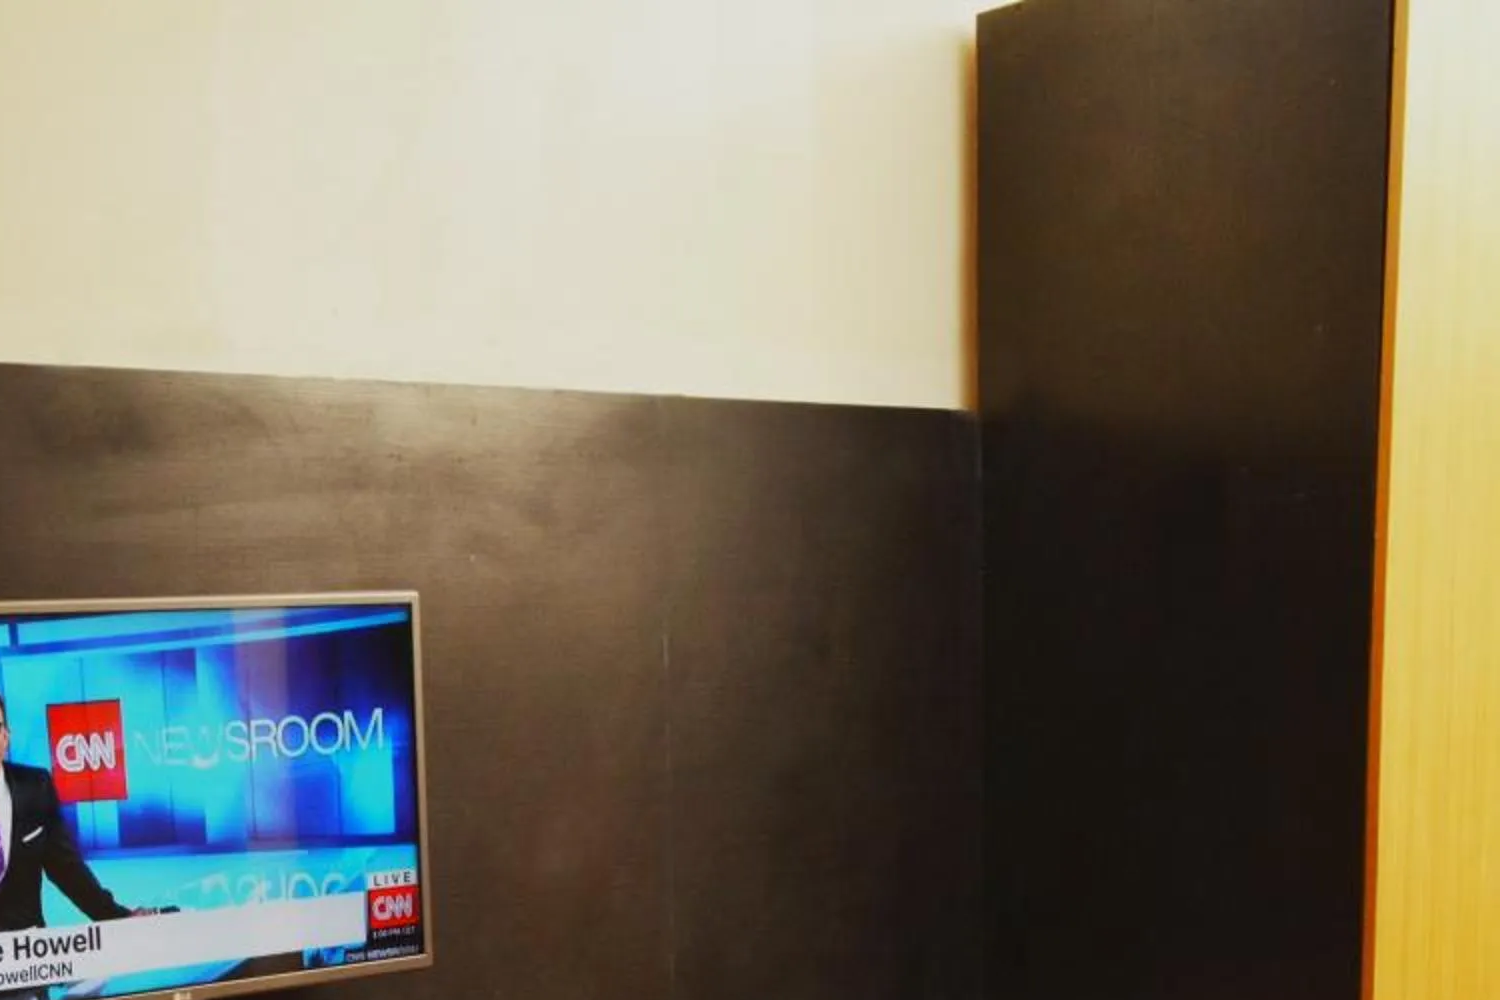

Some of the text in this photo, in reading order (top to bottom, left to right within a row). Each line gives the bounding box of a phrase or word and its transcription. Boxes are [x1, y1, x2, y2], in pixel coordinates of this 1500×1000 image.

[55, 707, 384, 773] CNN NEWSROOM
[373, 871, 411, 886] LIVE
[372, 893, 413, 920] CNN
[13, 926, 101, 960] Howell
